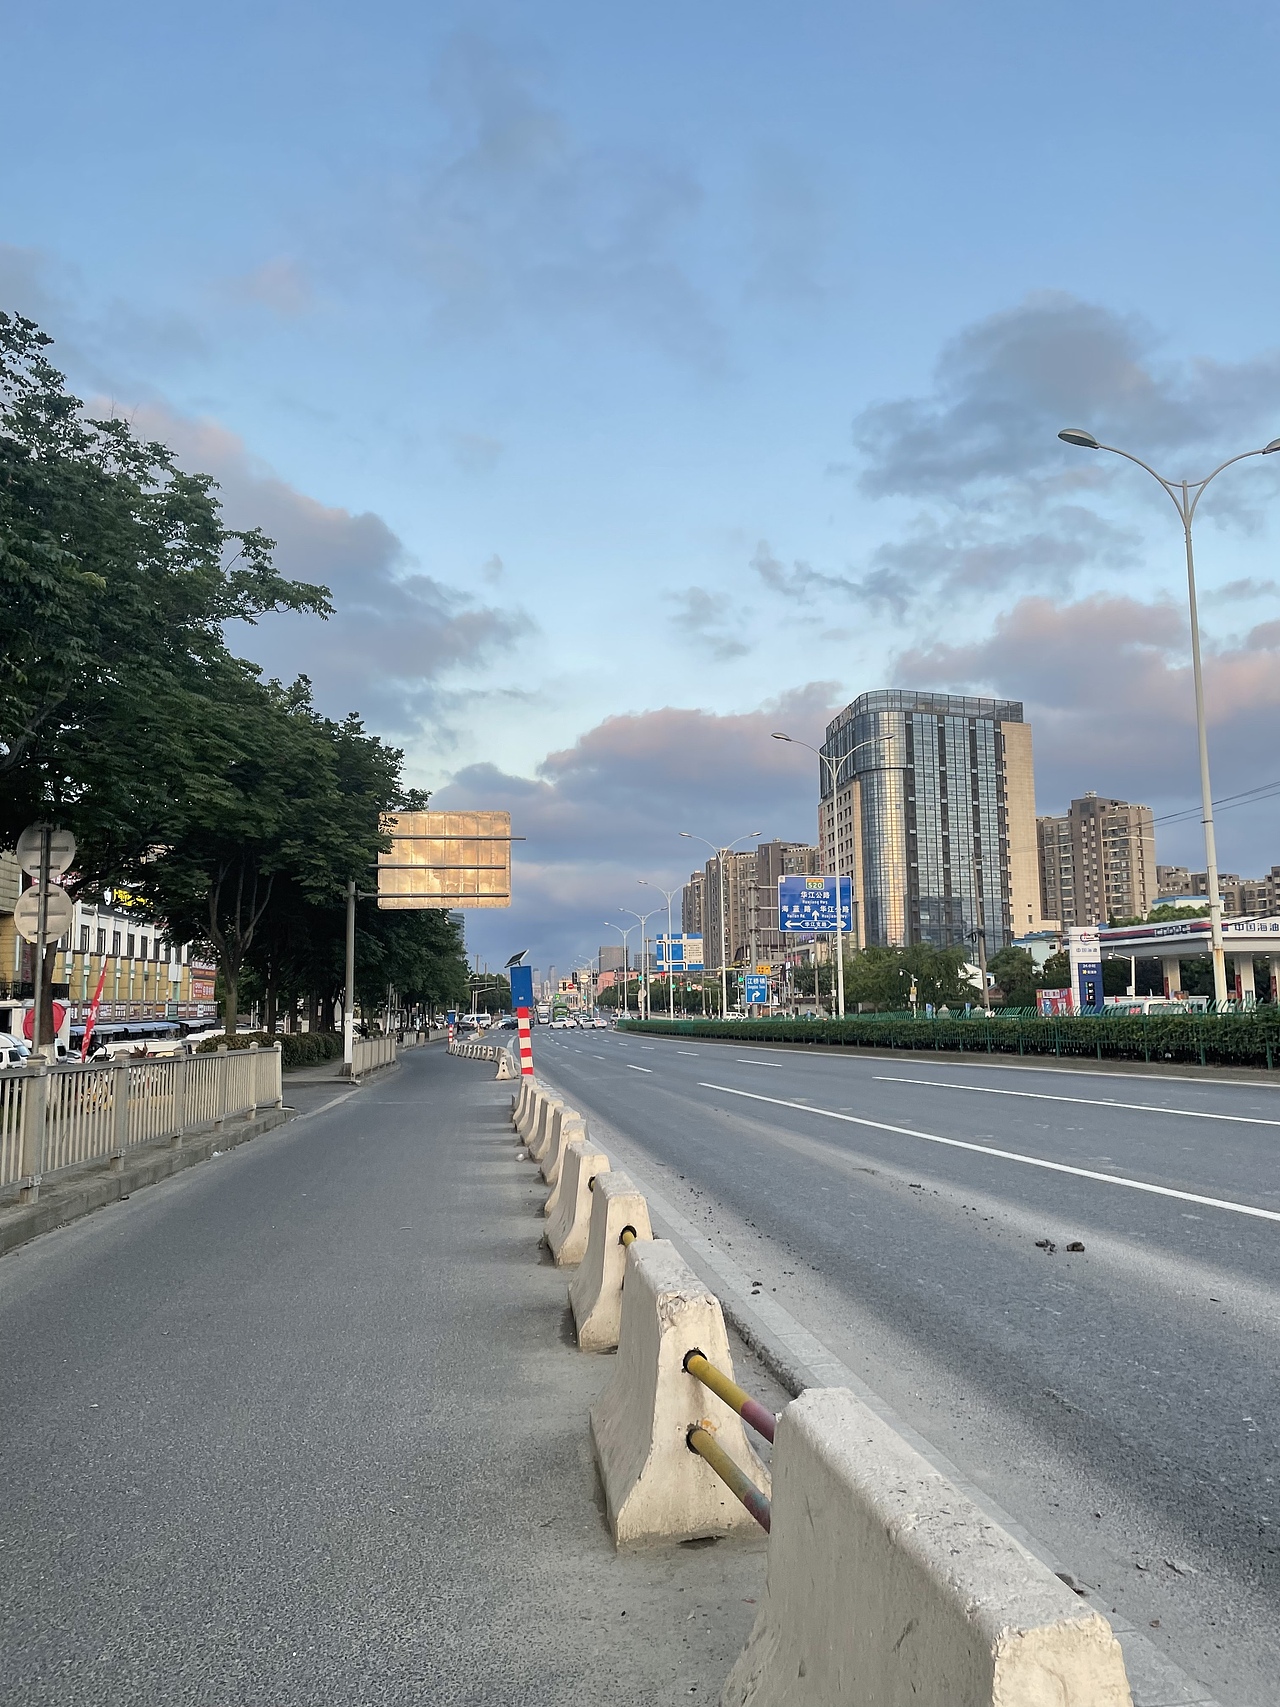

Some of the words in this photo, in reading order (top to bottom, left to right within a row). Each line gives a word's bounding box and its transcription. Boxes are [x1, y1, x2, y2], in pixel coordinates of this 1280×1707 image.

[800, 891, 830, 899] 华江公路
[1234, 922, 1279, 932] 中国海油
